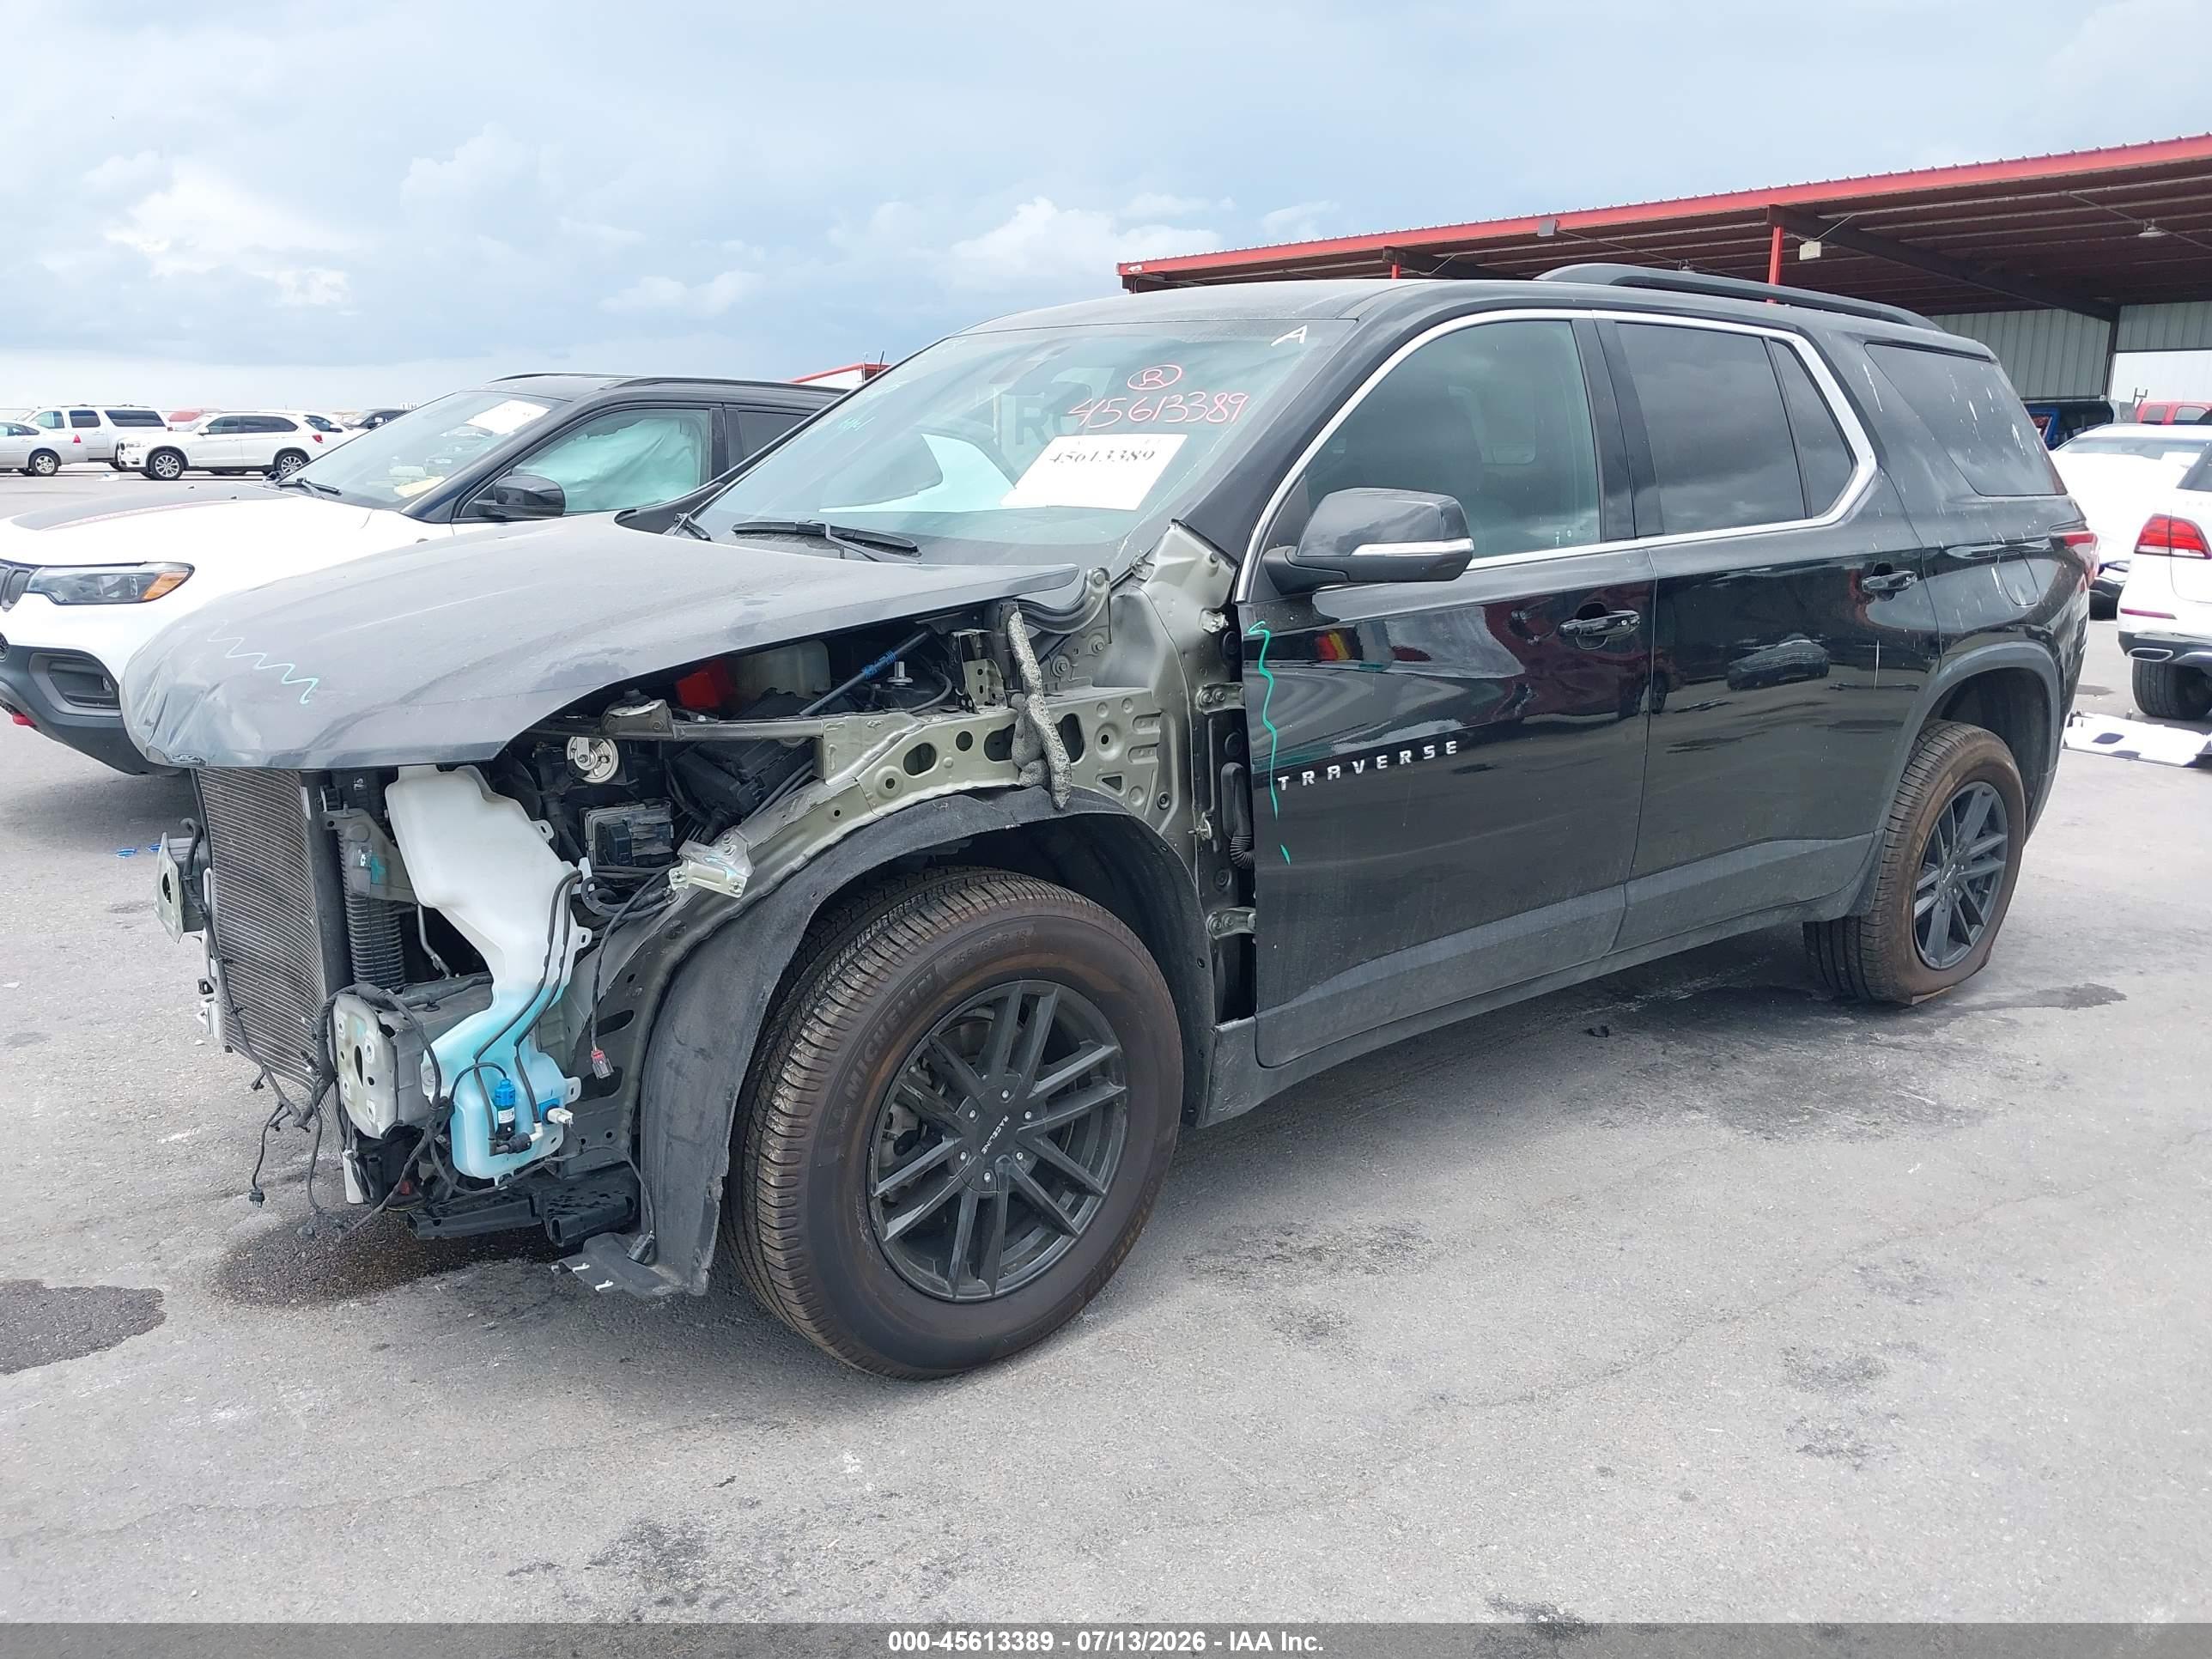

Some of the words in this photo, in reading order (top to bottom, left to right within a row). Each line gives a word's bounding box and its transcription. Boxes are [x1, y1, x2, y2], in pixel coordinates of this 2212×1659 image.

[1271, 325, 1307, 346] A
[1067, 391, 1249, 428] 45613389
[1048, 449, 1157, 465] 45613389
[1277, 740, 1458, 791] TRAVERSE
[845, 973, 933, 1100] MICHELIN
[981, 1115, 1009, 1155] RACELINE
